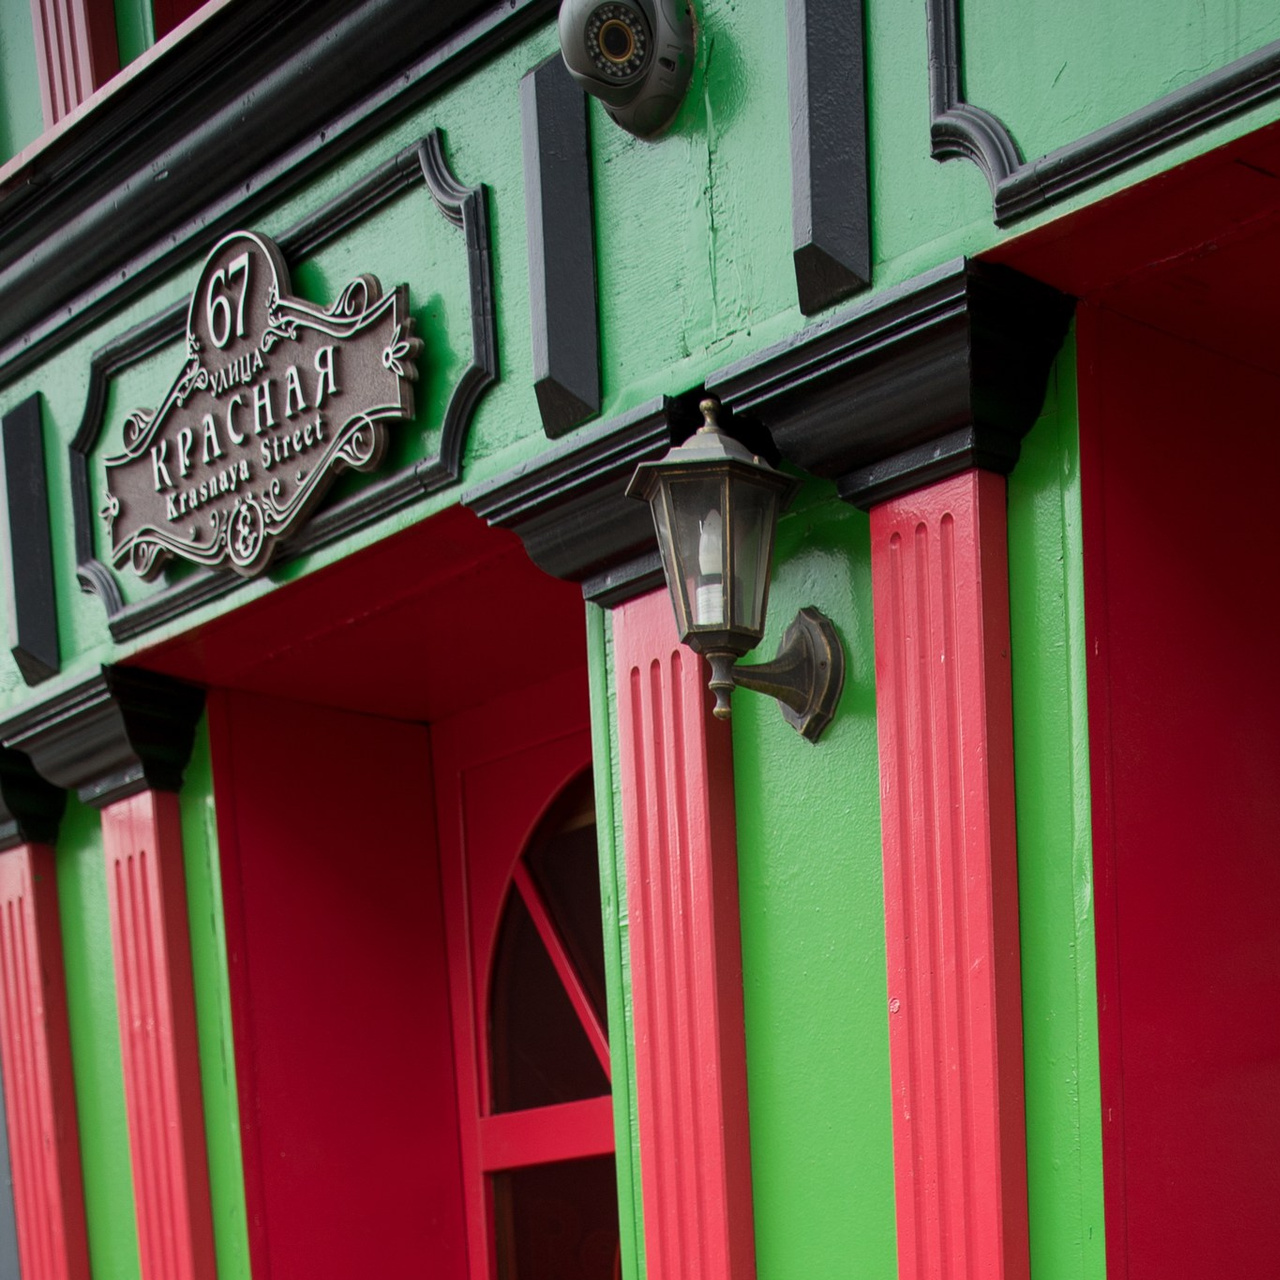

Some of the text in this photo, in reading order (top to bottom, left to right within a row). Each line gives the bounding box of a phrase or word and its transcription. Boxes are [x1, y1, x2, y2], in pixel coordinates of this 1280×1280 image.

[206, 253, 249, 348] 67
[151, 345, 337, 492] КРАСНАЯ
[210, 349, 264, 398] УЛИЦА
[165, 414, 325, 521] Krasnaya Street
